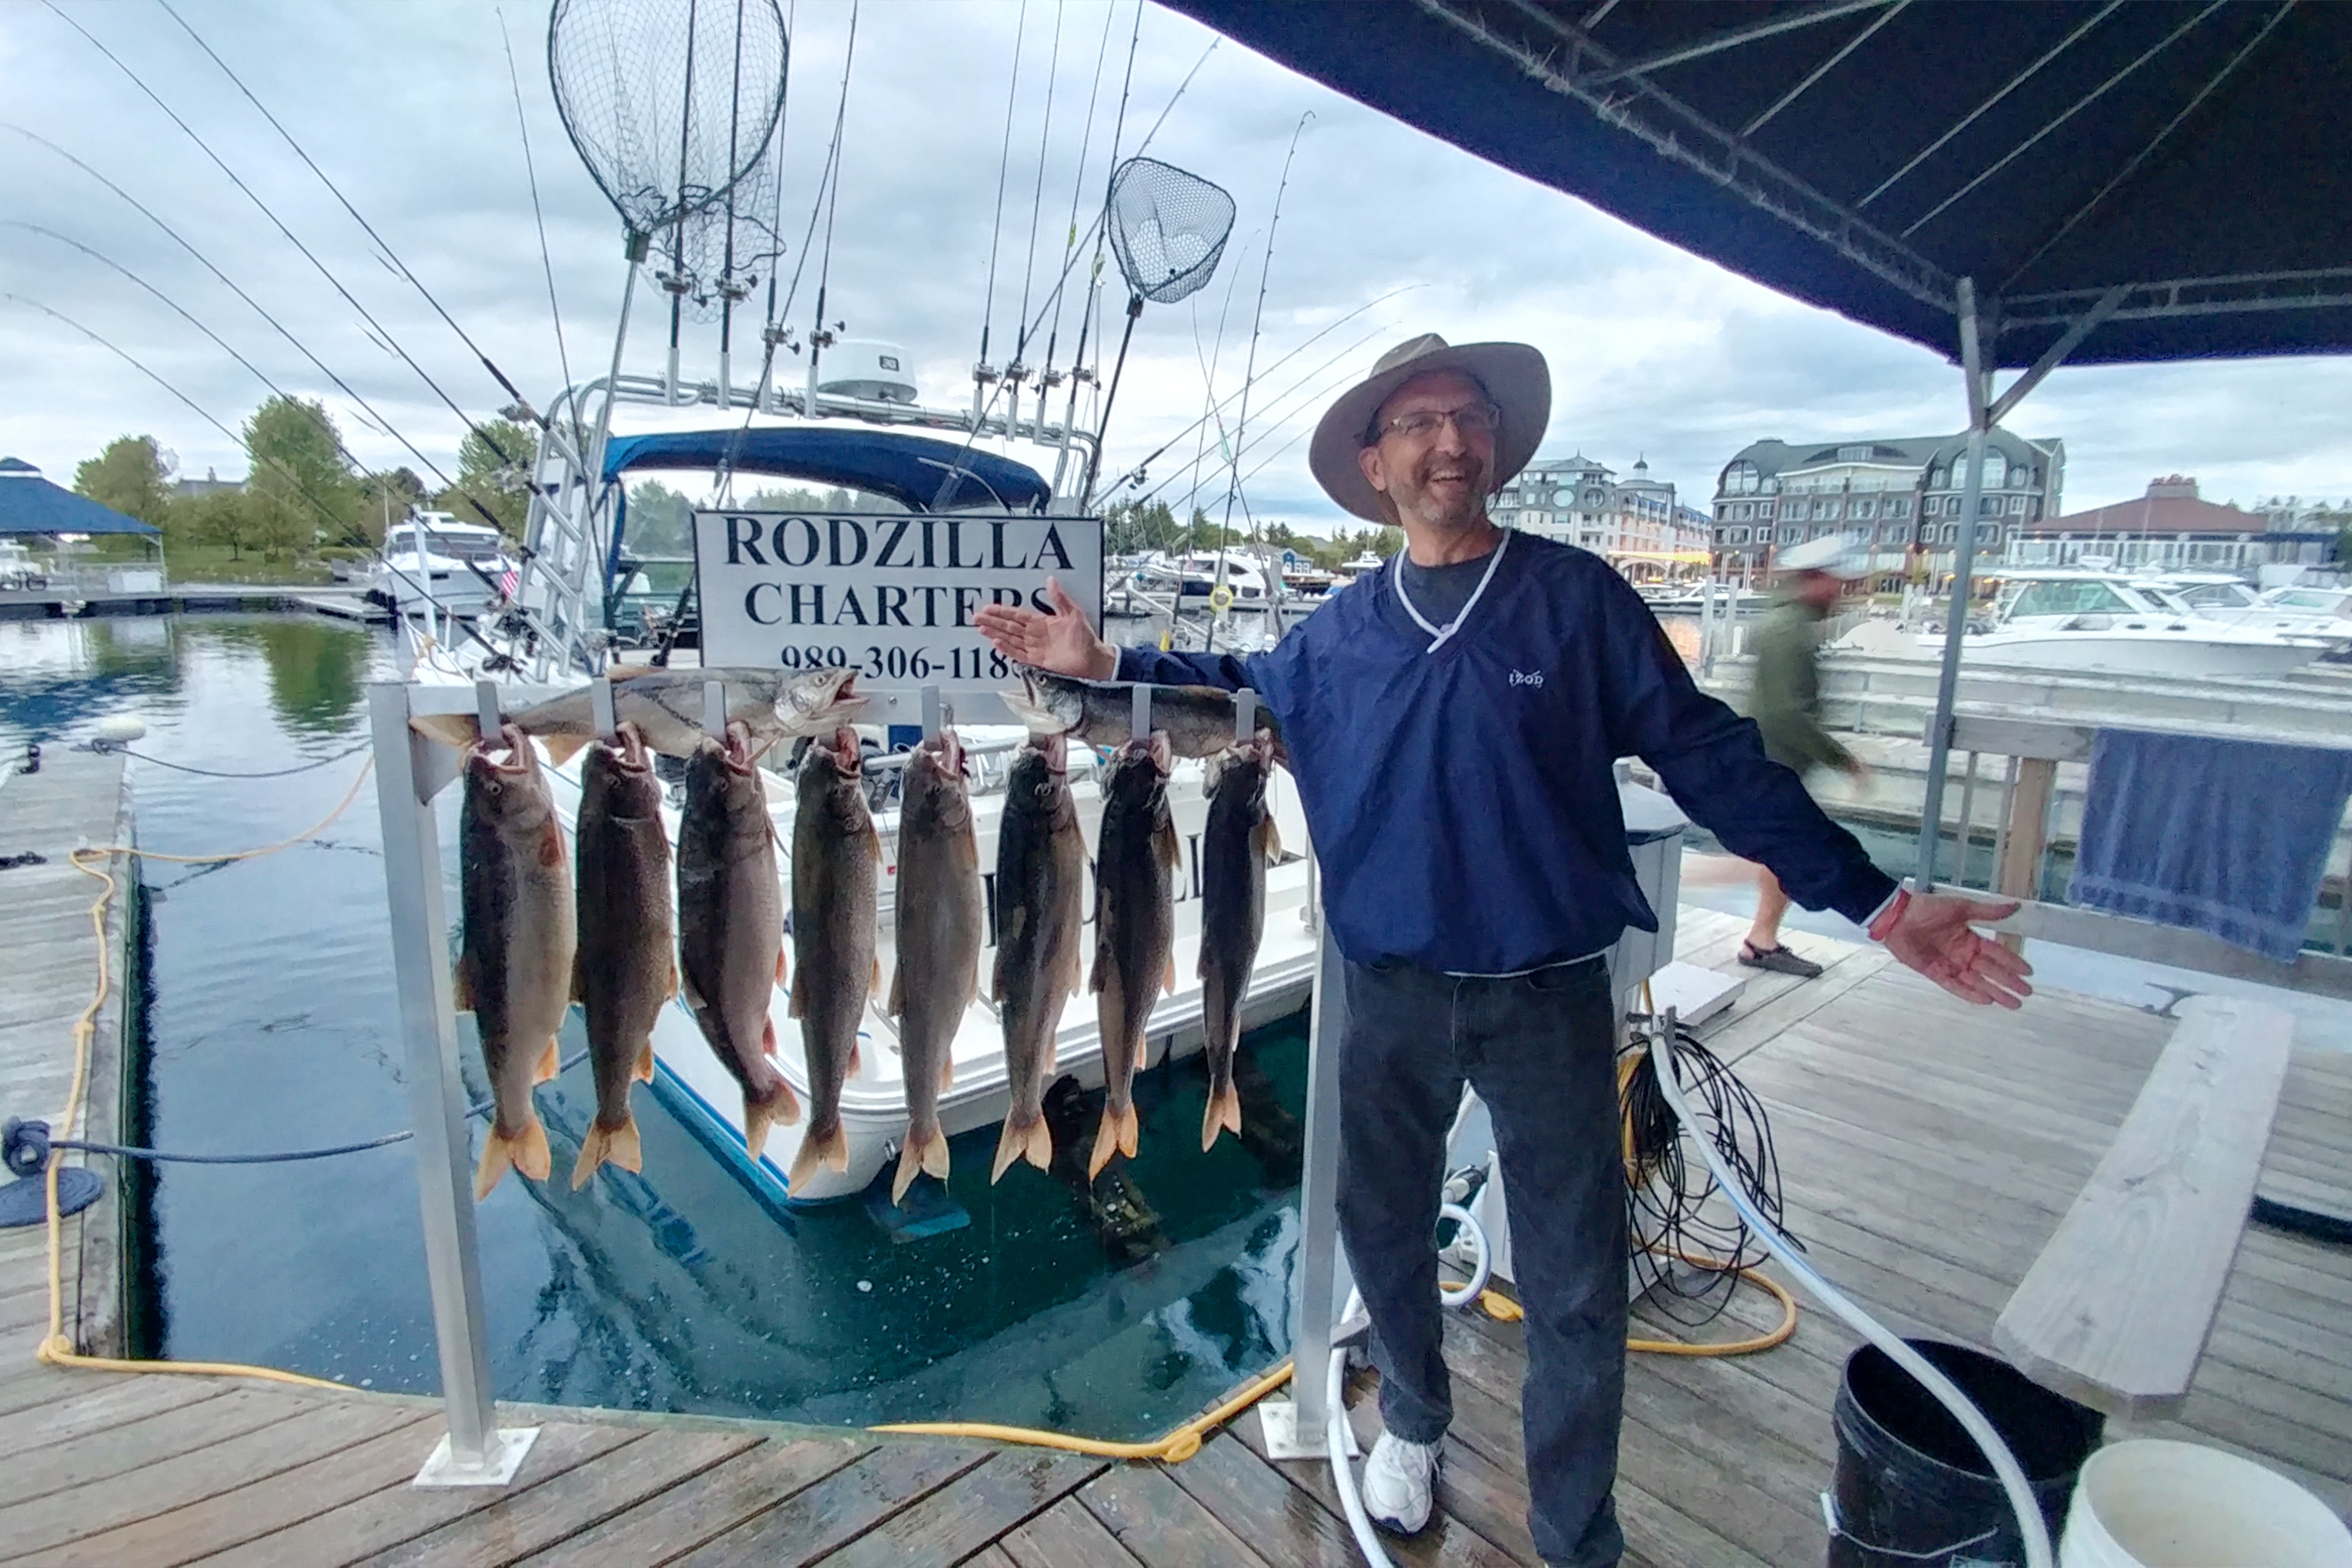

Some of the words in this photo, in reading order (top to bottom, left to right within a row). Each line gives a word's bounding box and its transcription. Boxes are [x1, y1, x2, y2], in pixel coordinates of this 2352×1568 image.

[724, 516, 1075, 570] RODZILLA
[781, 645, 1022, 679] 989-306-118
[1509, 670, 1544, 688] IZOD
